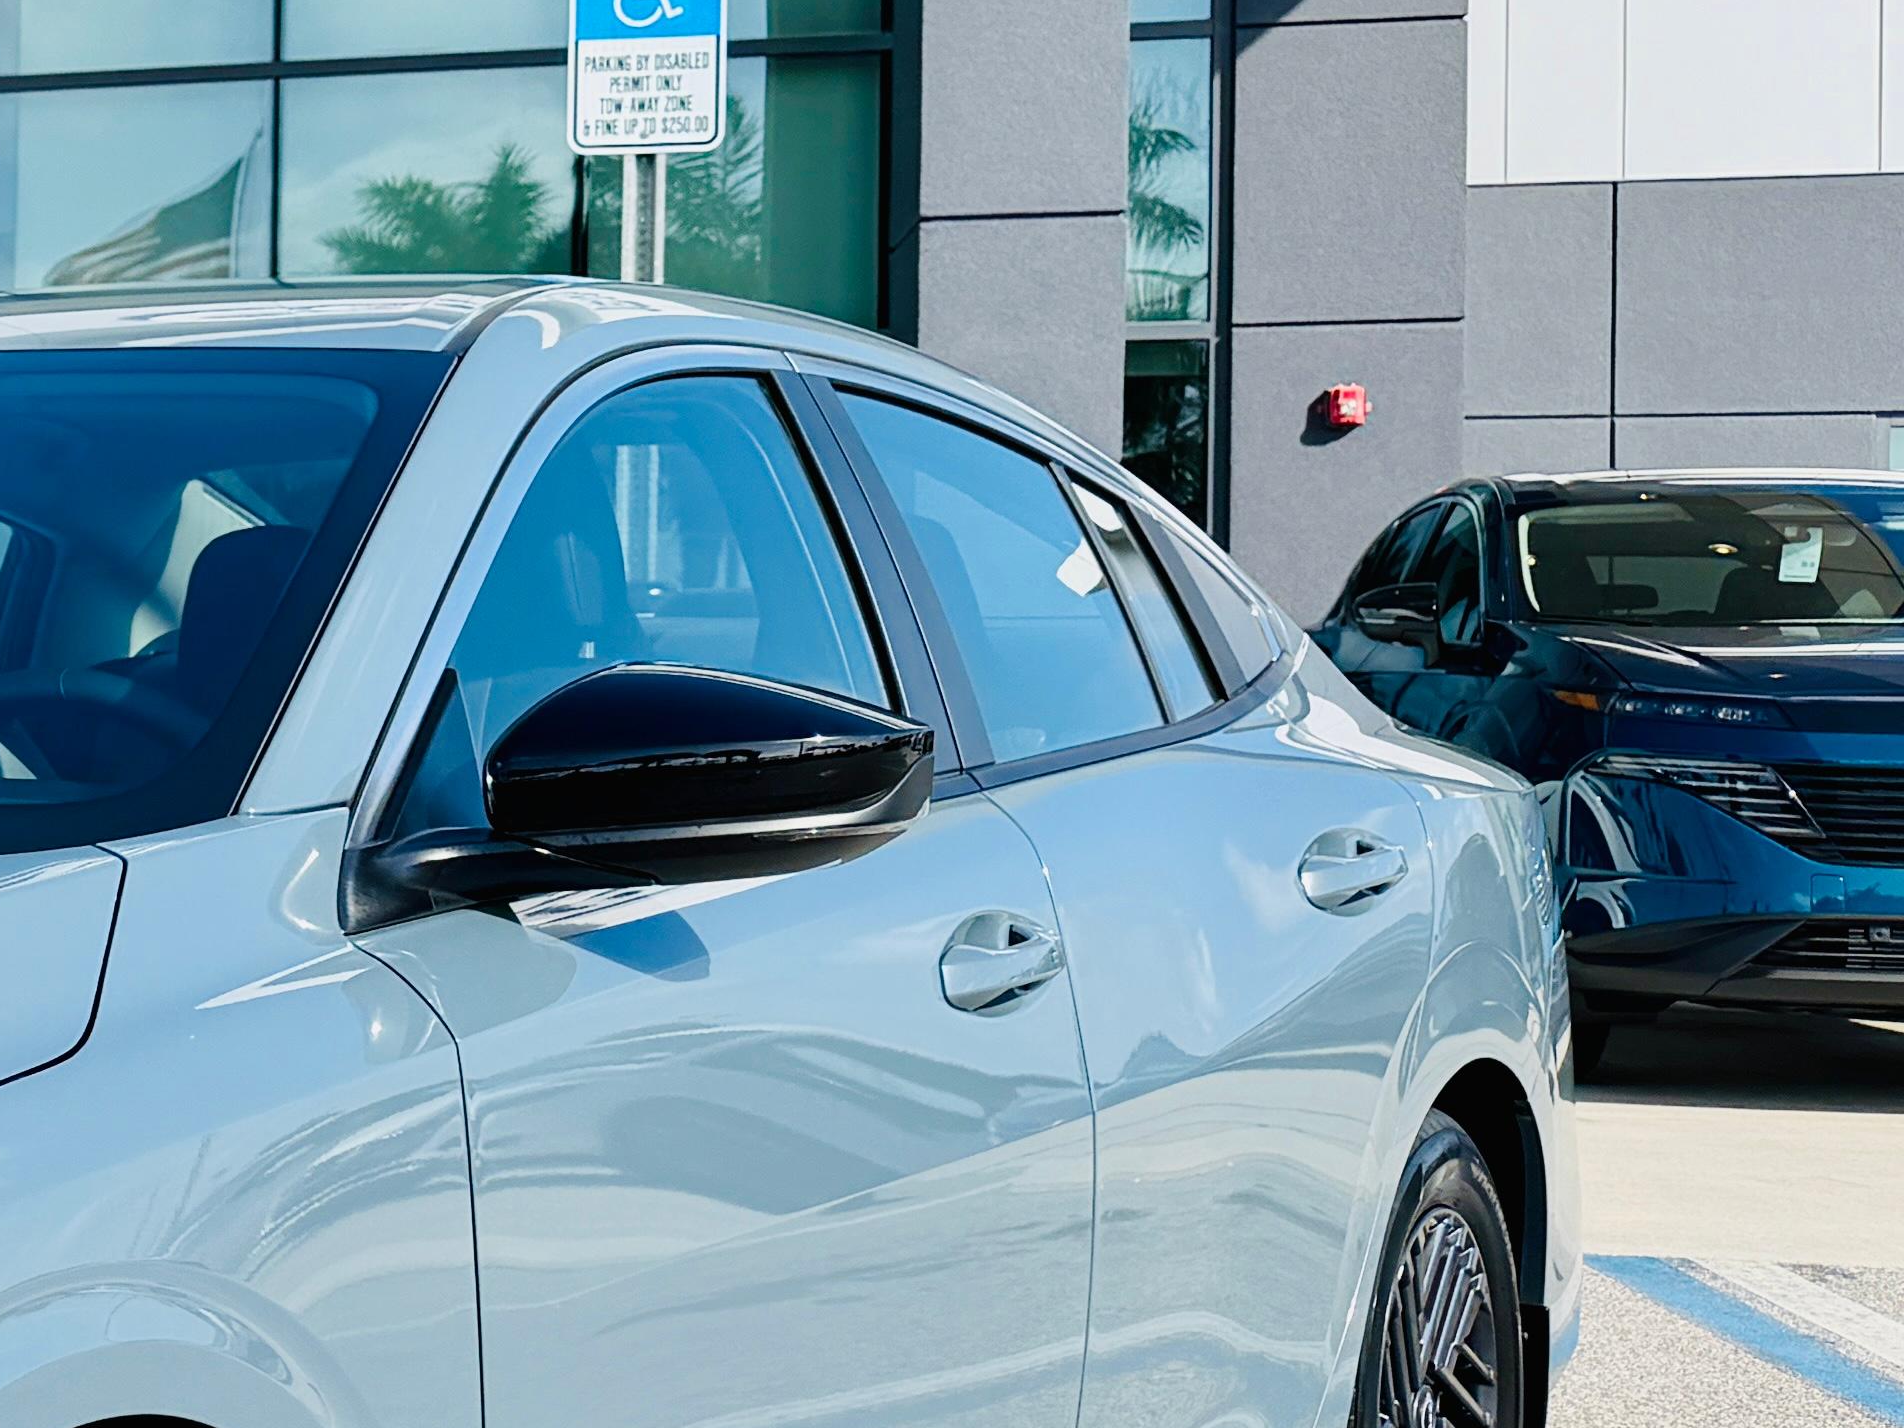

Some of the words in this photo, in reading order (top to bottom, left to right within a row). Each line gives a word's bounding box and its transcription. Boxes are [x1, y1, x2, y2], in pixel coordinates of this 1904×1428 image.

[584, 55, 632, 73] PARKING
[636, 54, 650, 71] BY
[655, 51, 710, 71] DISABLED
[610, 75, 651, 93] PERMIT
[656, 74, 683, 91] ONLY
[664, 94, 693, 113] ZONE
[595, 118, 619, 135] FINE
[624, 117, 638, 135] UP
[643, 116, 656, 135] TO
[662, 115, 709, 134] $250.00
